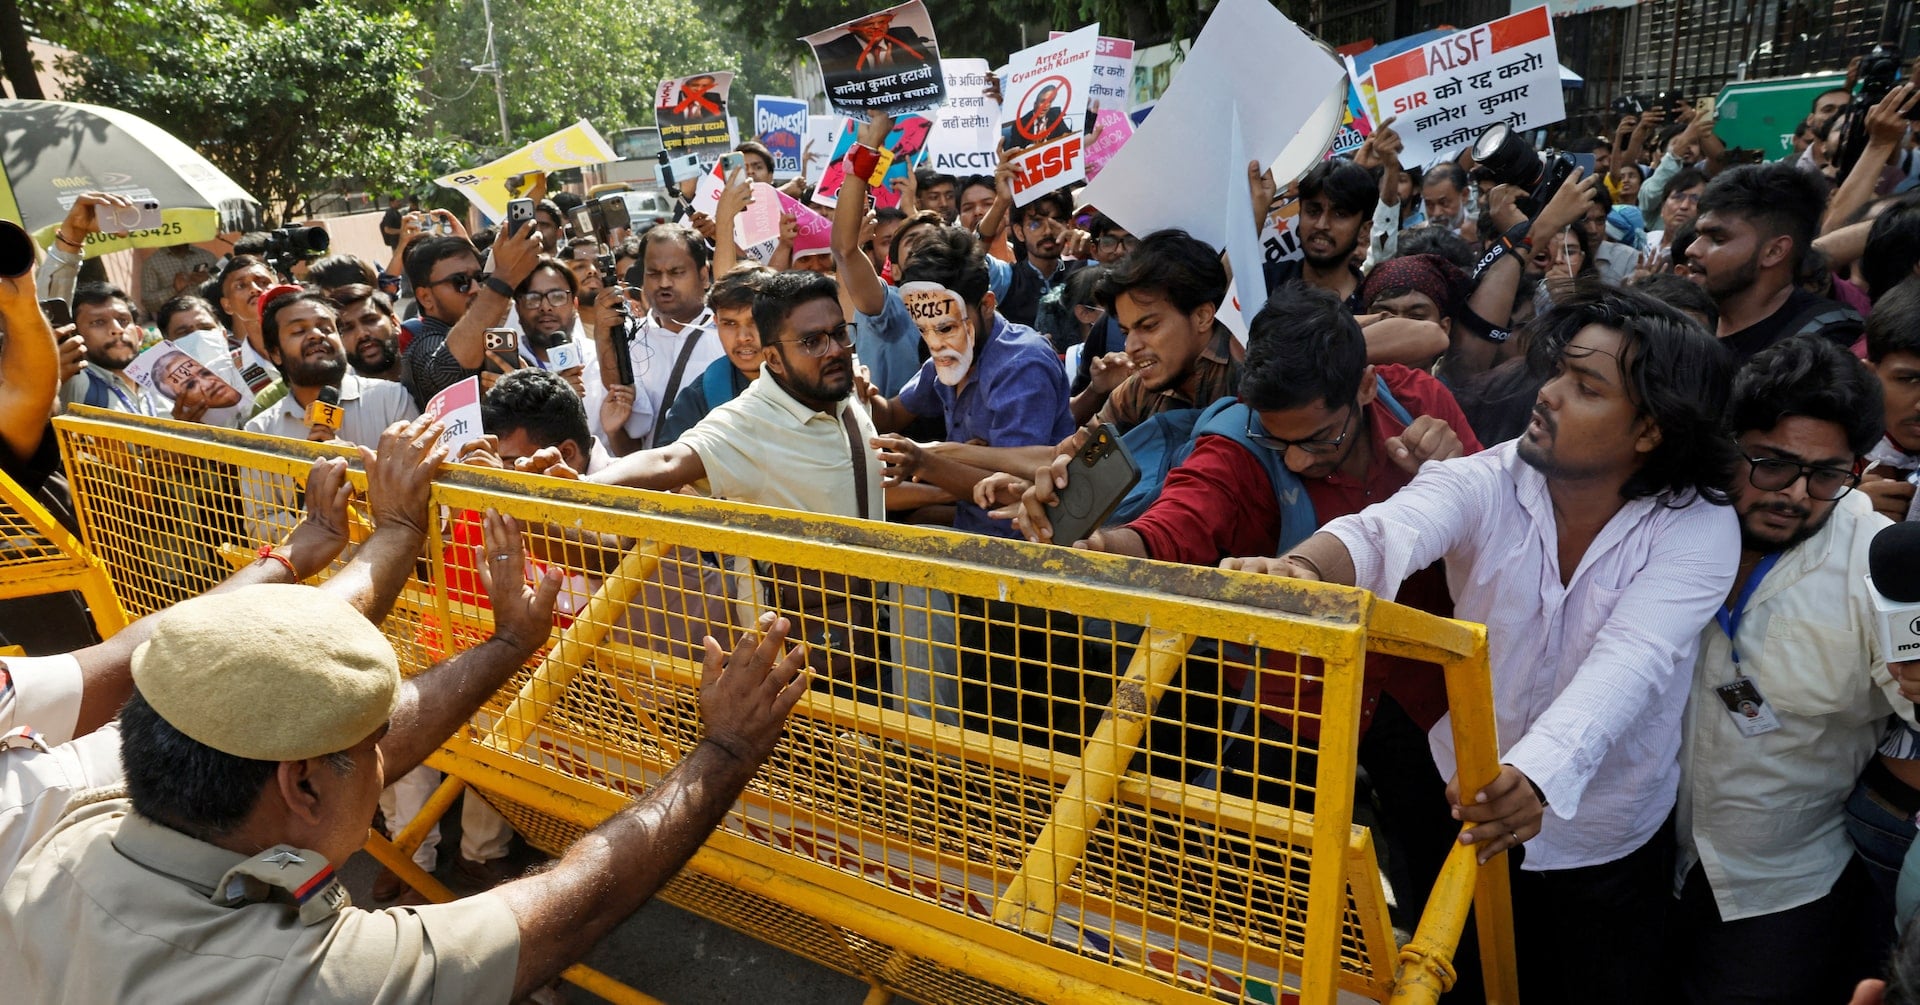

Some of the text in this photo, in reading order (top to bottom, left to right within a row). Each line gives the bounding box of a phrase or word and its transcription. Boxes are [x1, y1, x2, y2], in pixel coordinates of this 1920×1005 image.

[1012, 50, 1090, 83] Gyanesh Kumar
[1035, 48, 1068, 66] Arrest
[1429, 28, 1486, 76] AISF
[867, 75, 897, 93] कुमार
[899, 63, 932, 84] हटाओ
[1394, 53, 1543, 114] SIR को रद्द करो!
[866, 92, 901, 106] आयोग
[903, 83, 938, 99] बचाओ
[958, 97, 984, 107] हमला
[1414, 84, 1529, 132] ज्ञानेश कुमार
[758, 107, 806, 134] GYANESH
[1013, 138, 1081, 195] AISF
